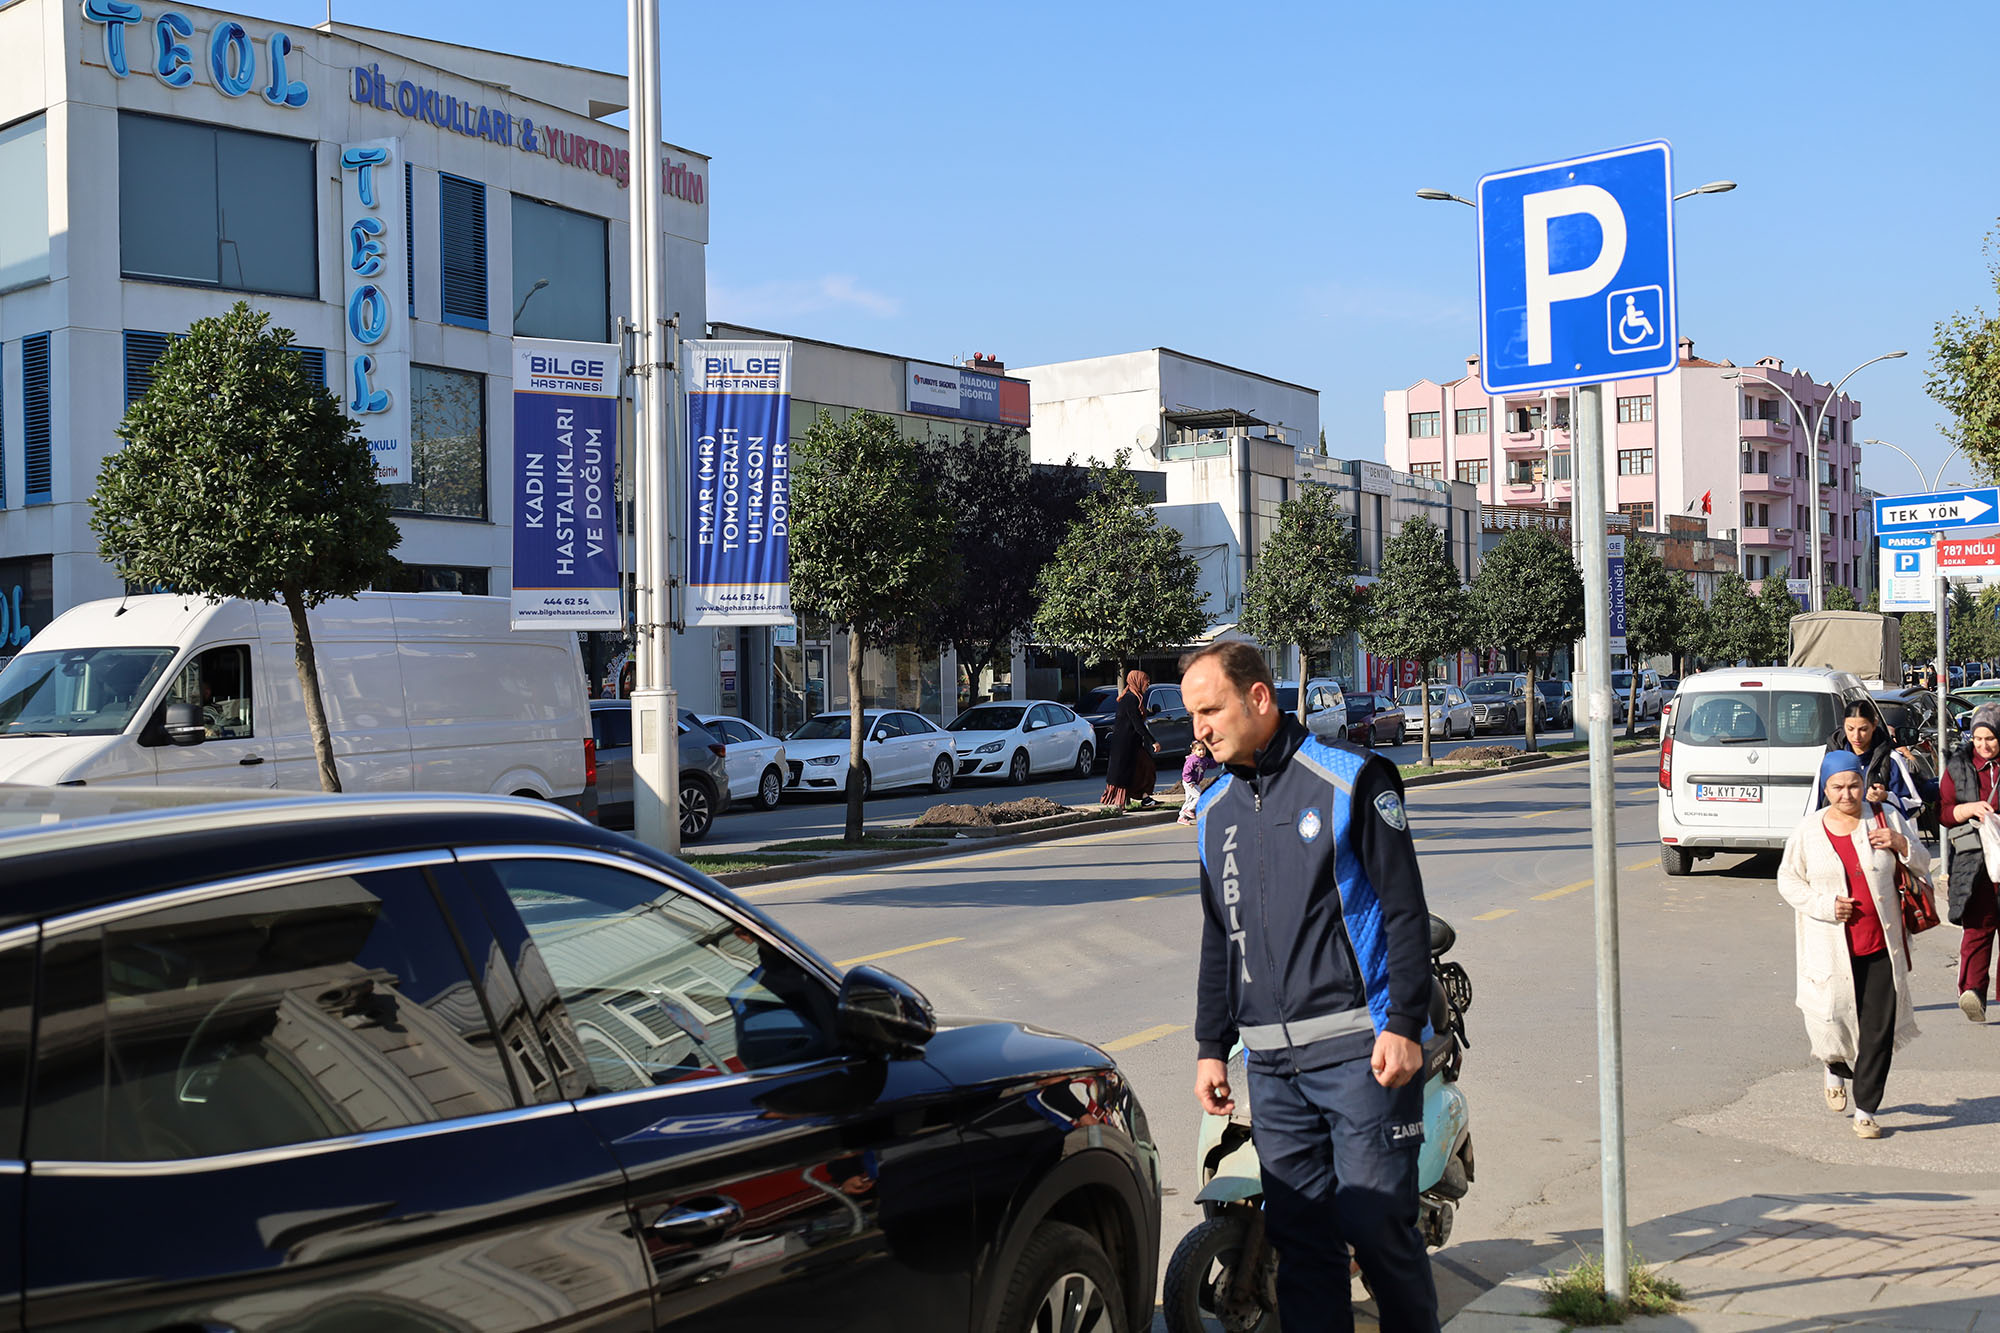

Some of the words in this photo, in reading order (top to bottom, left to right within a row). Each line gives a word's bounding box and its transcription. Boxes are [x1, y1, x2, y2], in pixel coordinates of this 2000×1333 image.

[82, 0, 310, 109] TEOL
[352, 62, 393, 111] DİL
[397, 80, 513, 147] OKULLARI
[519, 118, 539, 152] &
[341, 147, 393, 414] TEOL
[1523, 184, 1627, 366] P
[960, 375, 997, 390] ANADOLU
[960, 386, 993, 401] SİGORTA
[580, 428, 602, 519] DOĞUM
[698, 435, 716, 481] (MR)
[526, 453, 544, 528] KADIN
[556, 408, 575, 575] HASTALIKLARI
[699, 487, 714, 545] EMAR
[719, 428, 739, 552] TOMOGRAFİ
[748, 437, 764, 544] ULTRASON
[772, 443, 787, 537] DOPPLER
[1889, 509, 1918, 522] TEK
[1928, 504, 1958, 519] YÖN
[587, 528, 604, 558] VE
[1888, 537, 1927, 546] PARK54
[1901, 555, 1914, 570] P
[1943, 545, 1962, 556] 787
[754, 593, 765, 601] 54
[1614, 565, 1624, 630] POLİKLİNİĞİ
[1703, 786, 1713, 796] 34
[1718, 787, 1735, 797] KYT
[1740, 787, 1758, 797] 742
[1392, 1121, 1424, 1139] ZABIT
